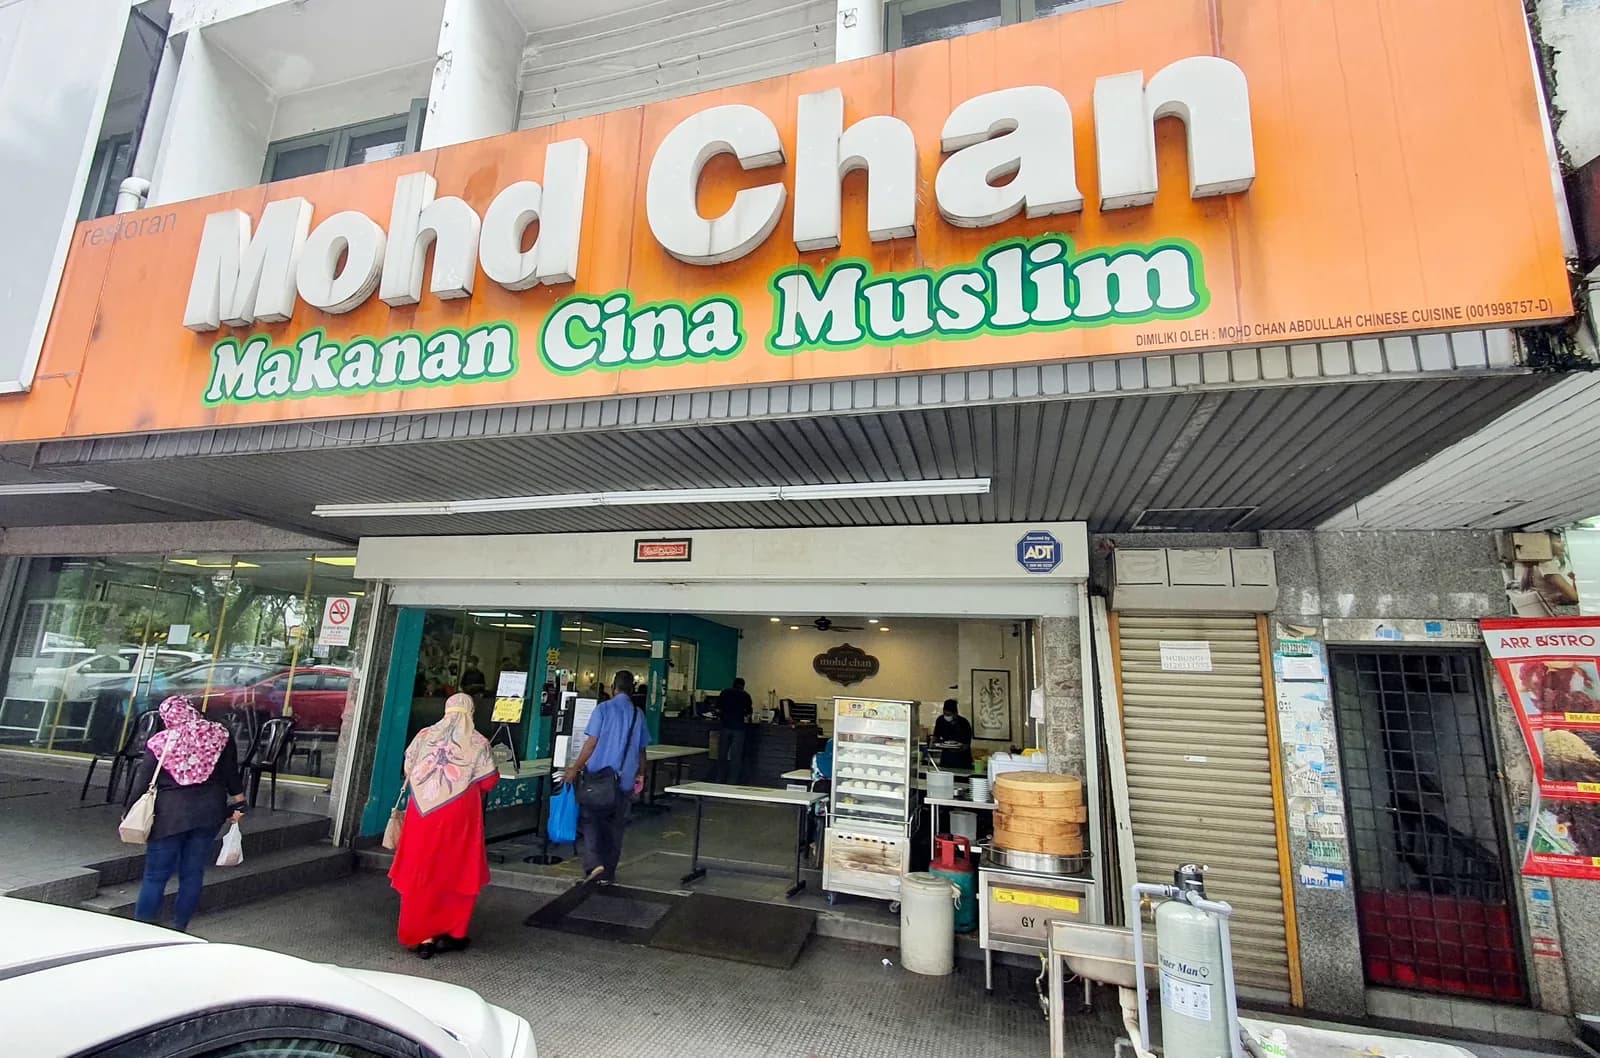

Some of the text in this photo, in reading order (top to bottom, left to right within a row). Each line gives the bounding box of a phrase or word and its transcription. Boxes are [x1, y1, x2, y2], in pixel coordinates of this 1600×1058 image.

[183, 56, 1256, 332] Mohd Chan
[82, 212, 177, 248] restoran
[204, 240, 1201, 402] Makanan Cina Muslim
[1136, 330, 1177, 346] DIMILIKI
[1180, 329, 1209, 341] OLEH
[1218, 324, 1251, 339] MOHD
[1254, 319, 1286, 336] CHAN
[1289, 315, 1351, 334] ABDULLAH
[1355, 311, 1408, 327] CHINESE
[1412, 306, 1462, 323] CUISINE
[1465, 298, 1553, 320] (001998757-D)
[1024, 545, 1054, 559] ADT
[1500, 634, 1595, 649] ARR BISTRO
[1177, 962, 1198, 976] Man
